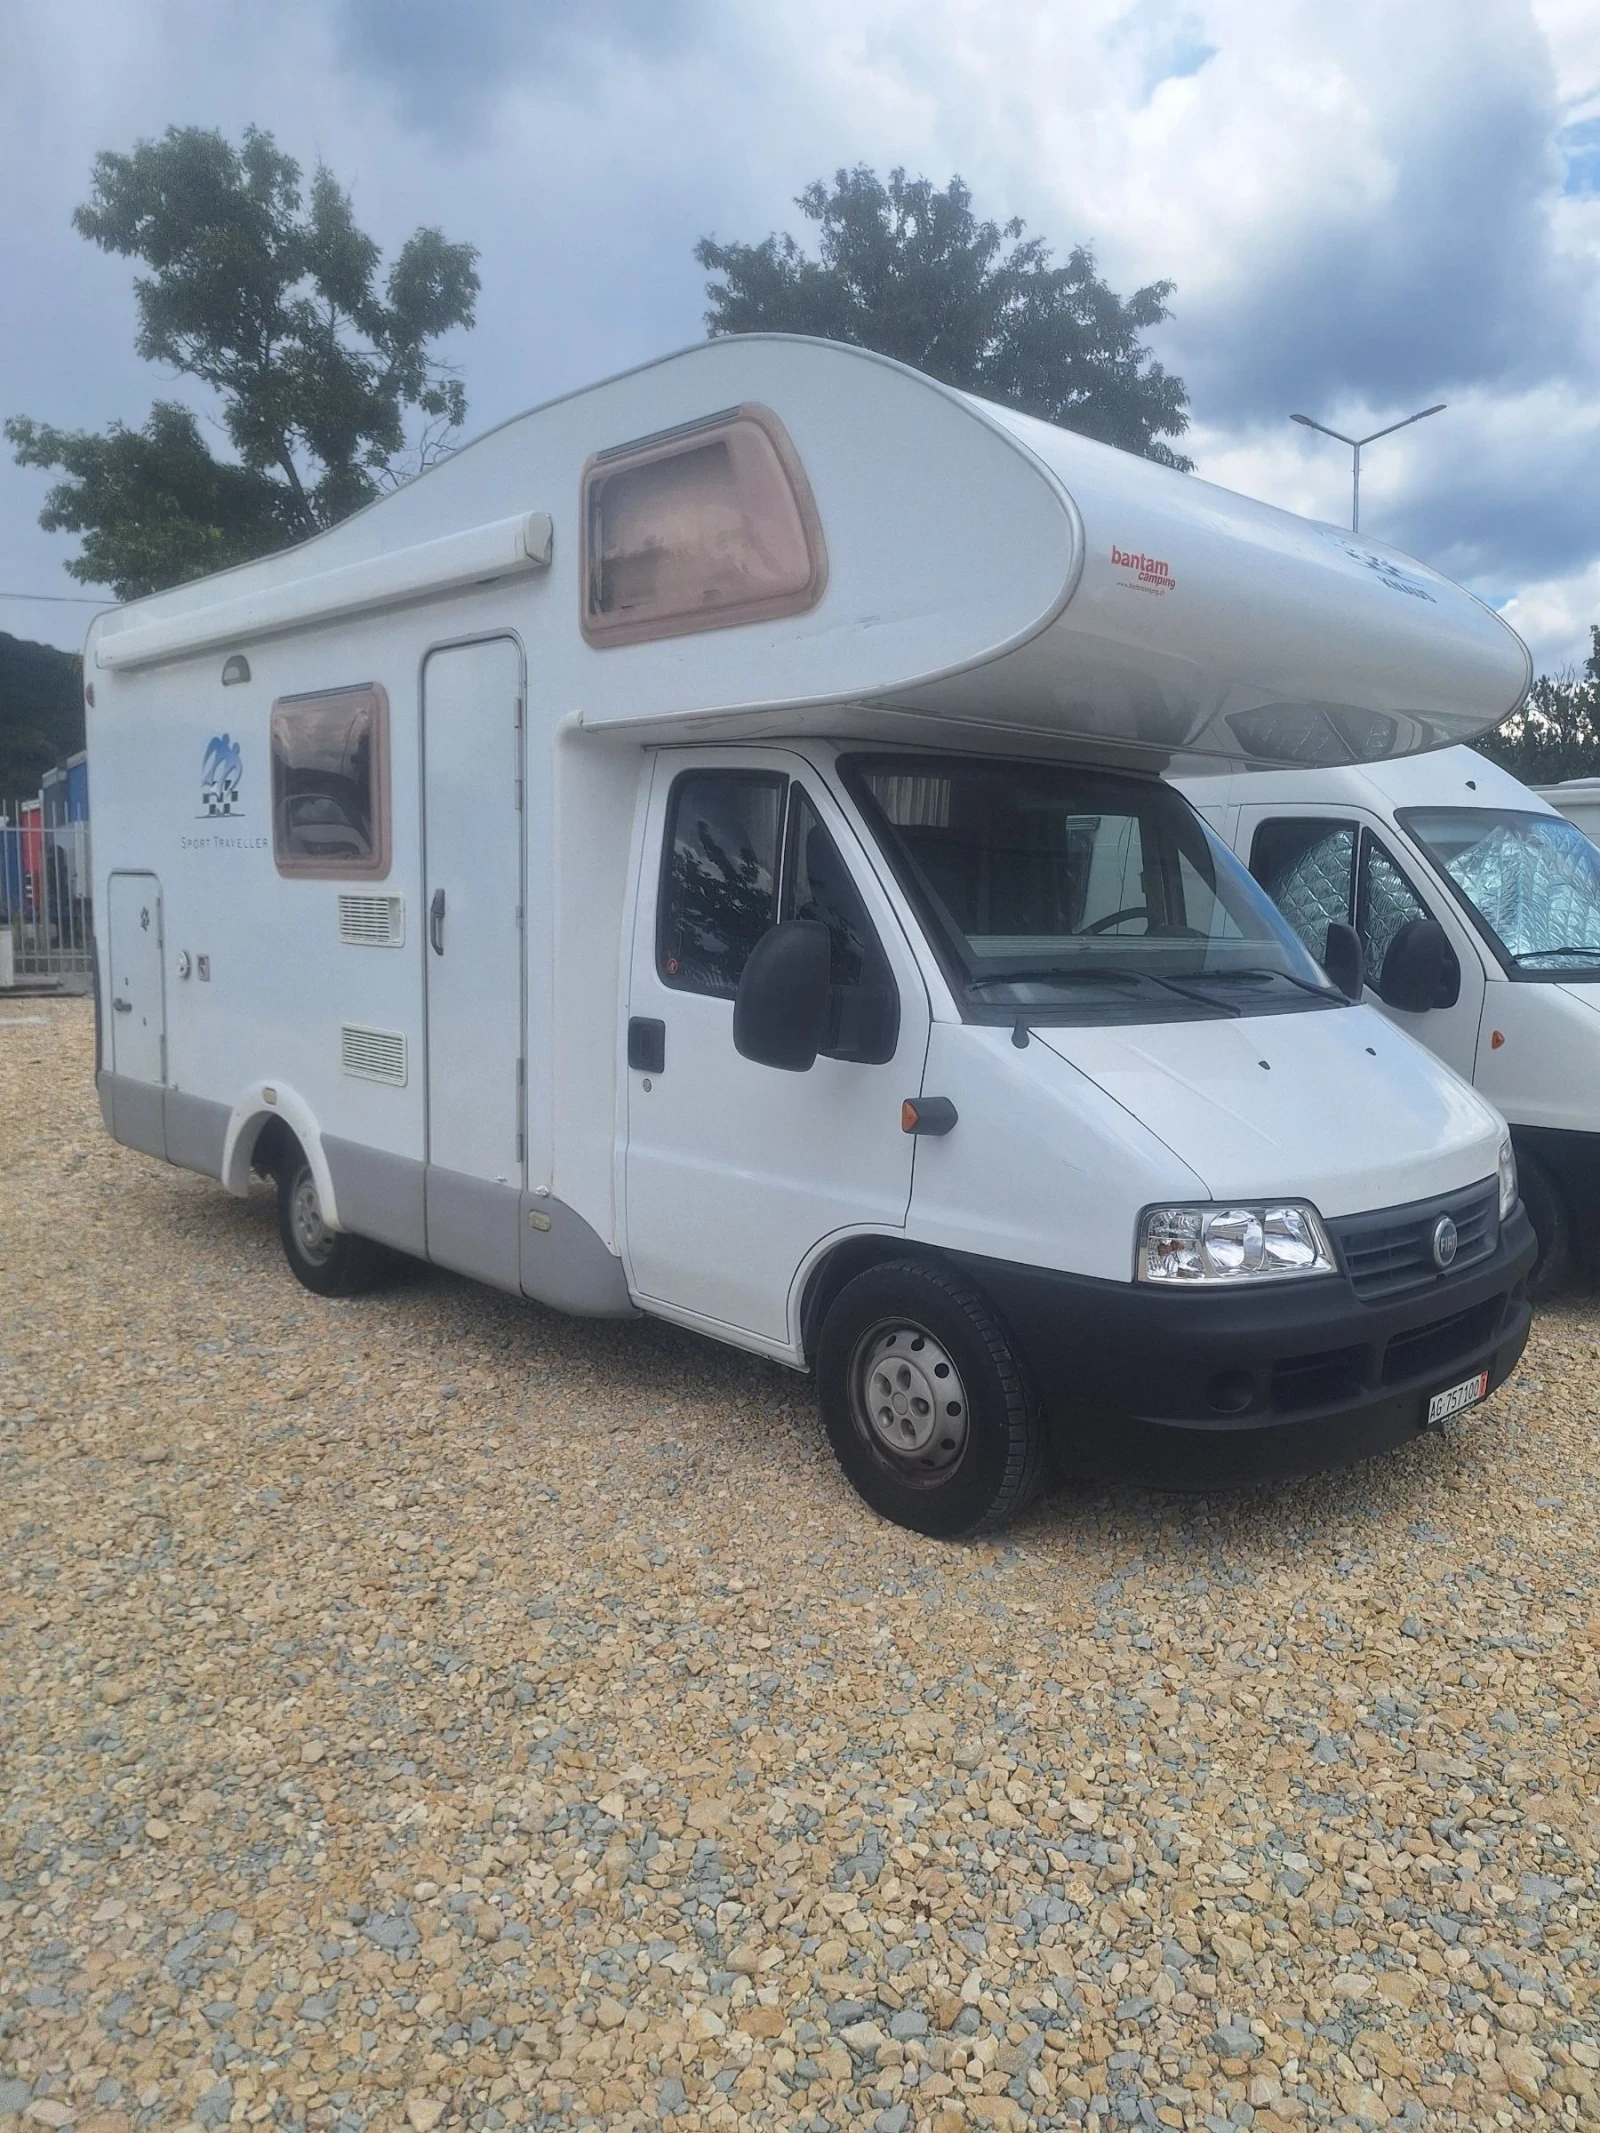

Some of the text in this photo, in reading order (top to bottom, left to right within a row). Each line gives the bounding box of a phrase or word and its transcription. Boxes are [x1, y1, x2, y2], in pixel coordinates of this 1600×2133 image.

[1111, 545, 1169, 577] bantam
[1138, 572, 1176, 590] camping
[181, 836, 269, 850] SPORT TRAVELLER
[1440, 1235, 1456, 1253] FIAT
